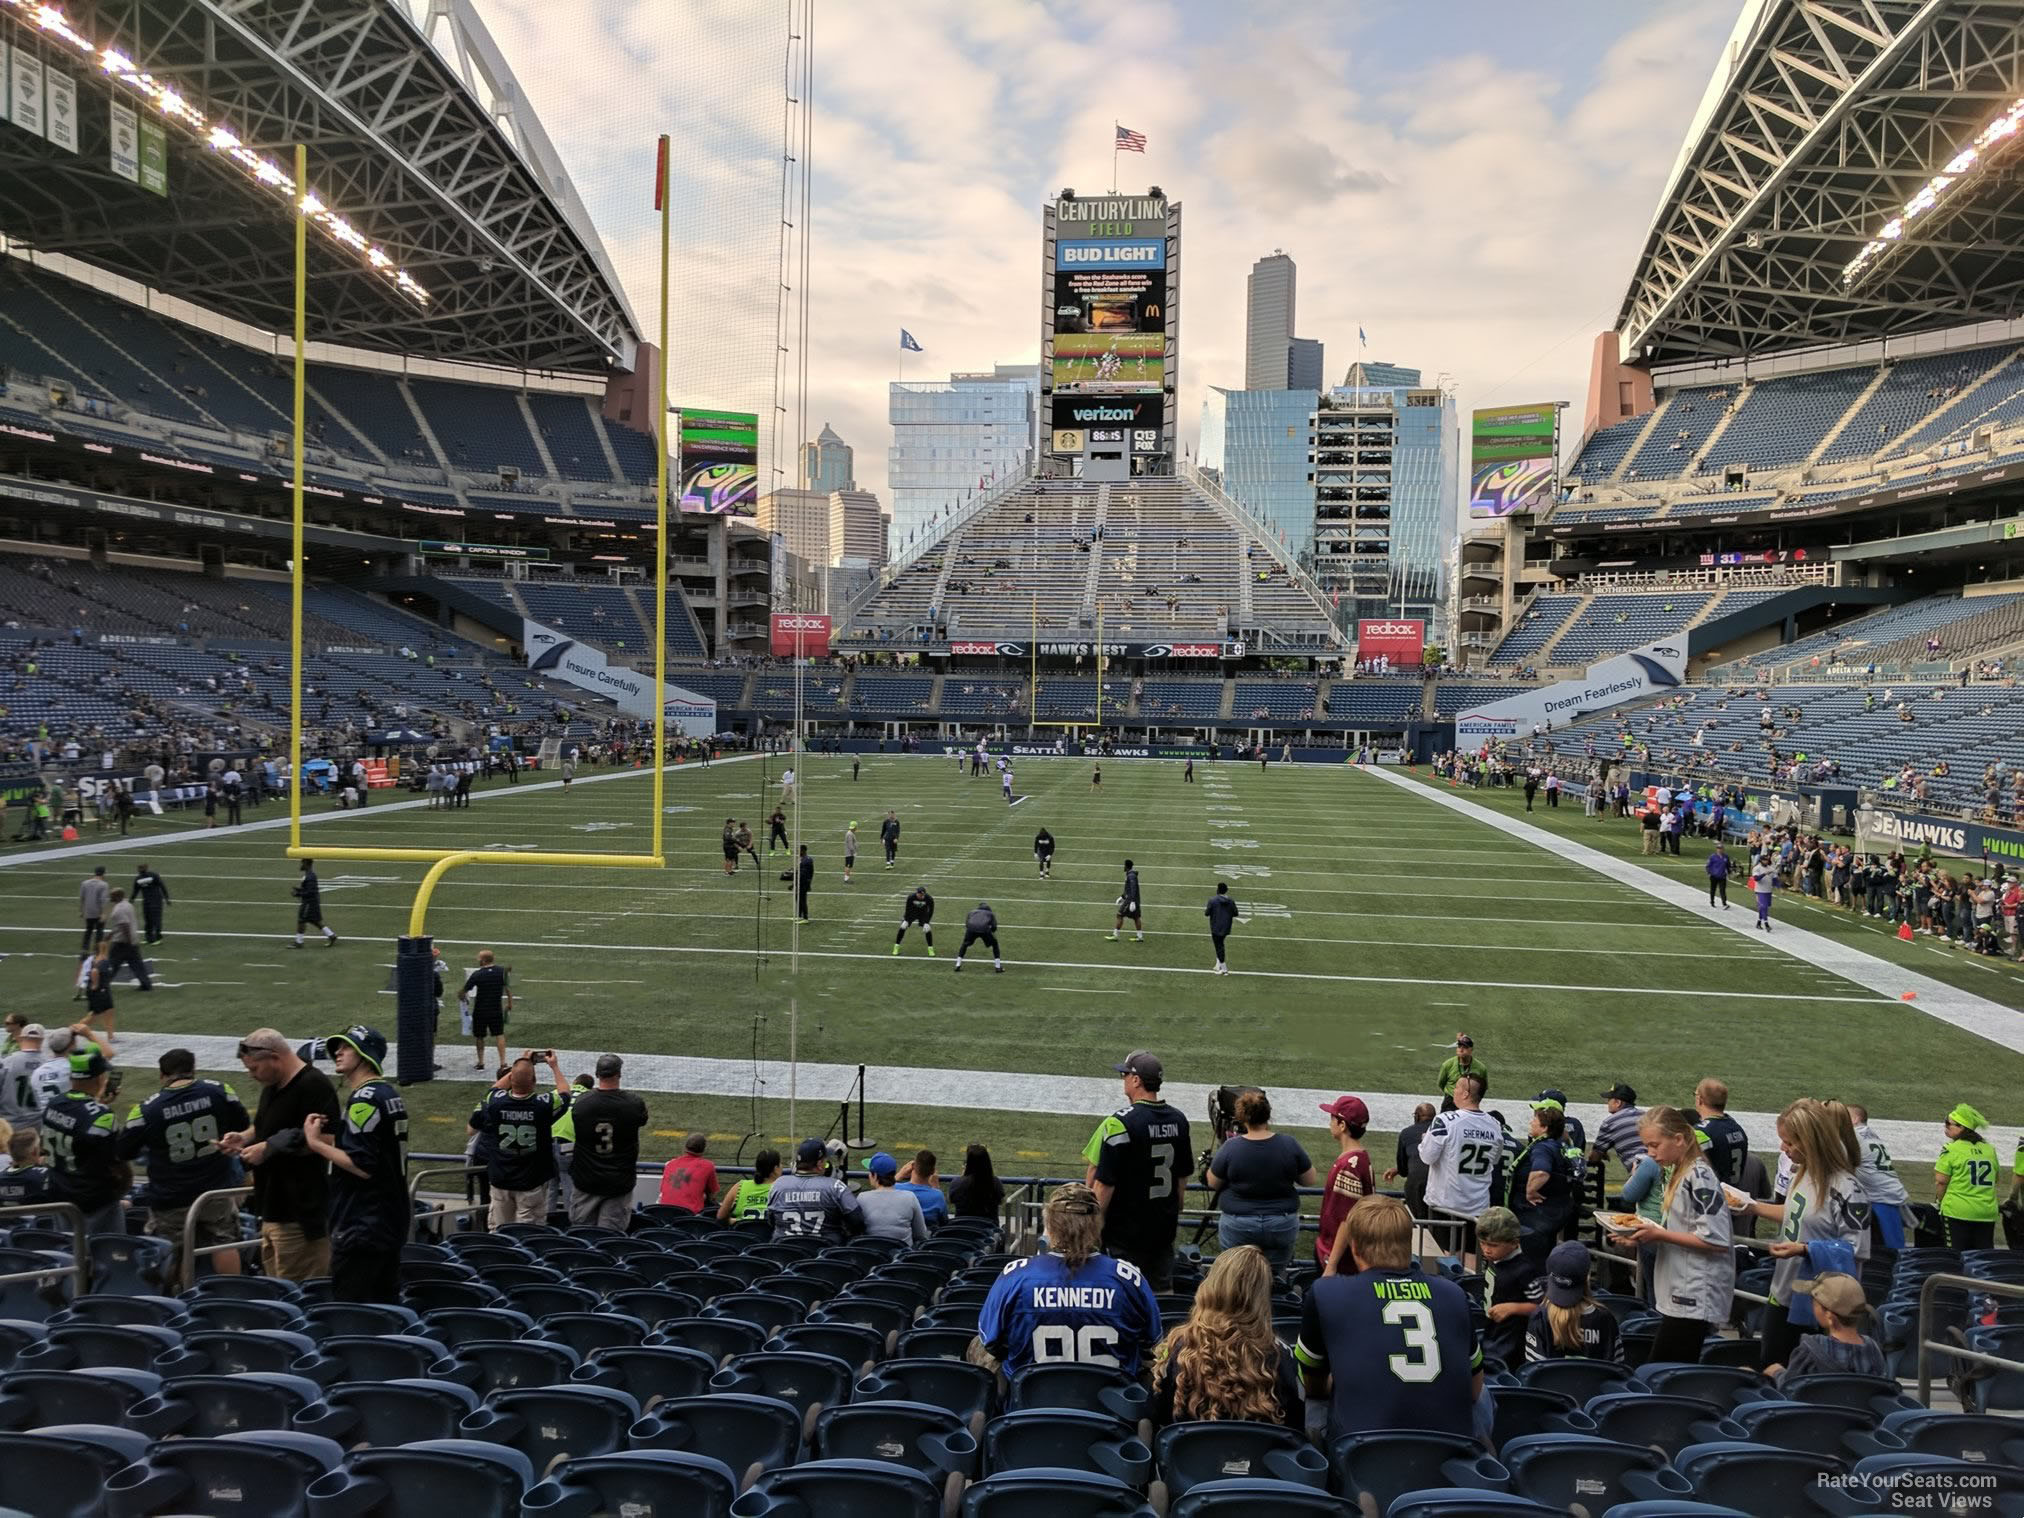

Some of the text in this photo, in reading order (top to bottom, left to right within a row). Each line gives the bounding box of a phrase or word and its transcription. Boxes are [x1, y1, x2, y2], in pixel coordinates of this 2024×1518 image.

[1090, 223, 1133, 236] FIELD
[1064, 247, 1156, 262] BUD LIGHT
[1073, 406, 1134, 420] verizon
[1134, 430, 1156, 441] Q13
[1135, 442, 1155, 450] FOX
[1720, 554, 1736, 563] 31
[1779, 551, 1787, 561] 7
[109, 635, 136, 643] DELTA
[1040, 644, 1088, 656] HAWKS
[566, 660, 640, 696] Insure Carefully
[1544, 677, 1642, 713] Dream Fearlessly
[1871, 810, 1965, 850] SEAHAWKS
[163, 1096, 212, 1120] BALDWIN
[501, 1110, 534, 1122] THOMAS
[1116, 1105, 1134, 1117] 3
[165, 1114, 218, 1163] 89
[498, 1124, 537, 1152] 29
[595, 1122, 614, 1154] 3
[1148, 1123, 1179, 1138] WILSON
[1463, 1128, 1494, 1141] SHERMAN
[1348, 1156, 1358, 1169] 4
[1458, 1143, 1493, 1175] 25
[1730, 1148, 1743, 1184] 3
[1150, 1143, 1174, 1199] 3
[1692, 1166, 1710, 1180] 12
[1967, 1160, 1993, 1186] 12
[785, 1192, 820, 1203] ALEXANDER
[783, 1211, 825, 1236] 37
[1783, 1191, 1808, 1244] 3
[1033, 1287, 1116, 1309] KENNEDY
[1374, 1282, 1432, 1299] WILSON
[1032, 1325, 1120, 1368] 96
[1382, 1300, 1442, 1382] 3
